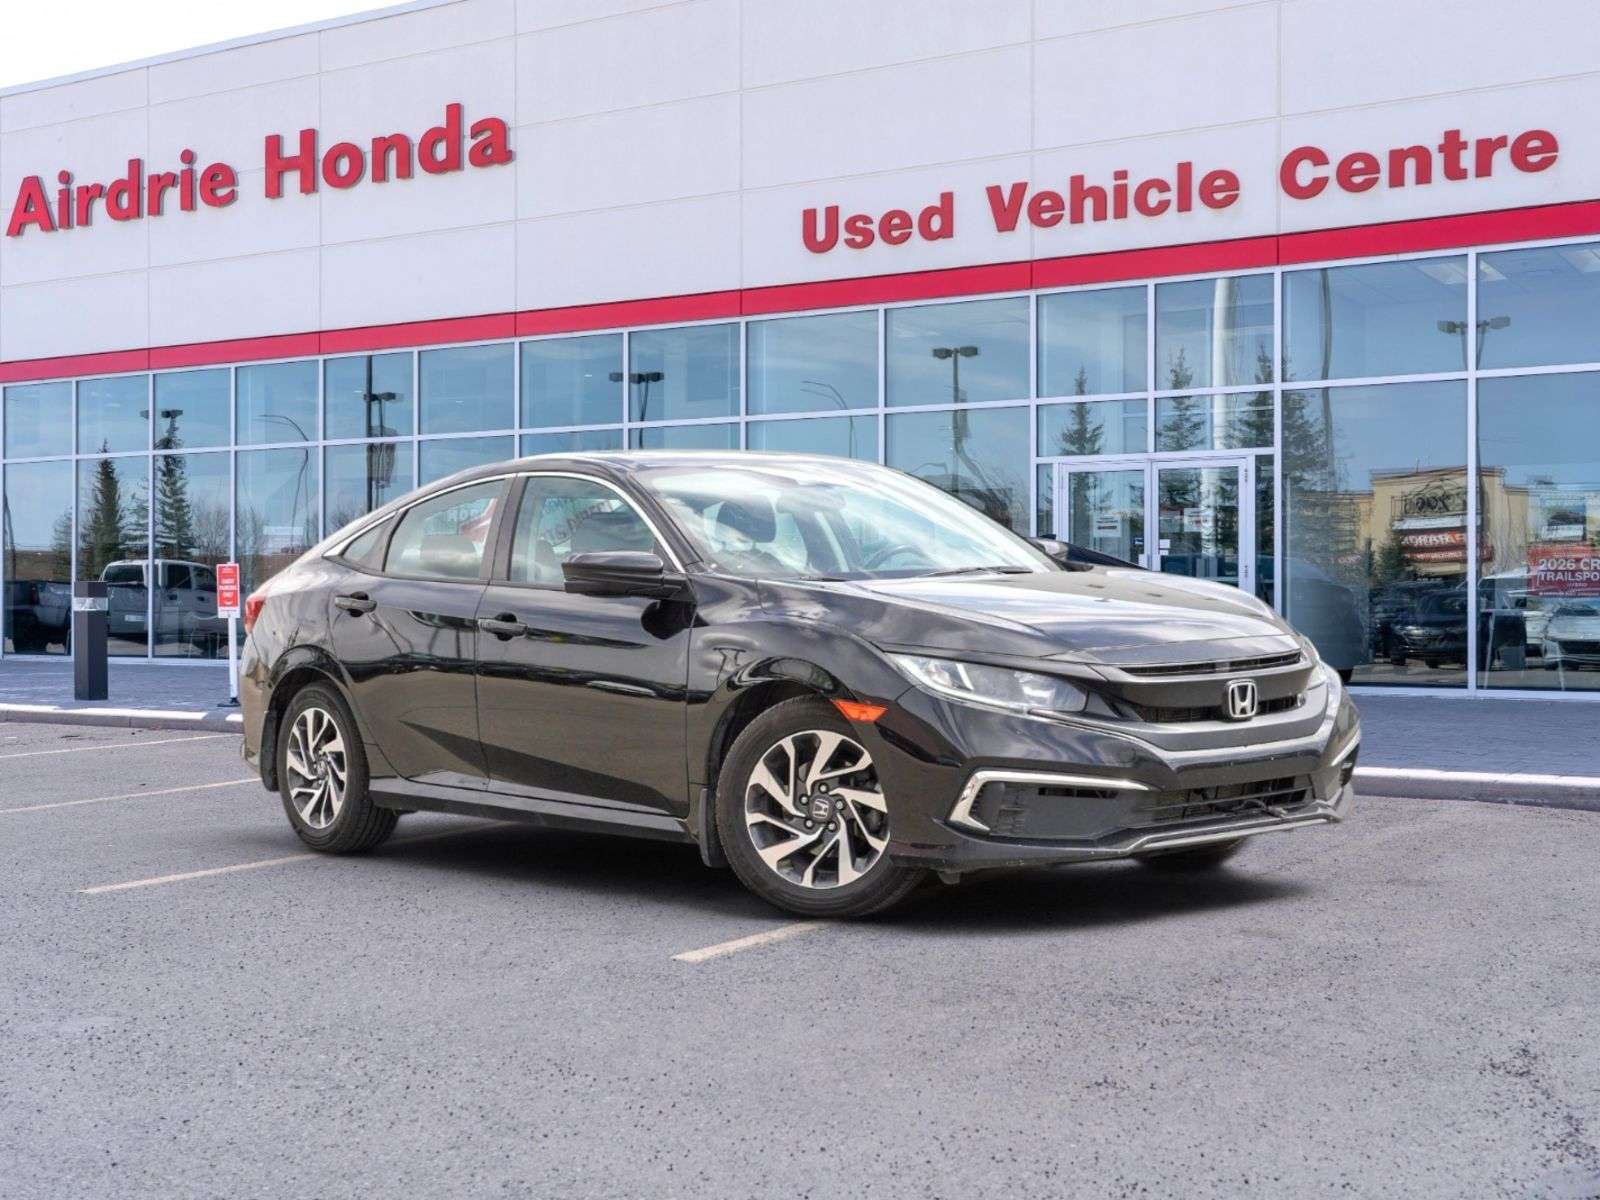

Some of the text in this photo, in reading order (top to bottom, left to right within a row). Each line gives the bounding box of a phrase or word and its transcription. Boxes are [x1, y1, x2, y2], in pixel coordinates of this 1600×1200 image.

[7, 103, 514, 237] Airdrie Honda
[803, 130, 1558, 253] Used Vehicle Centre
[1539, 558, 1576, 570] 2026
